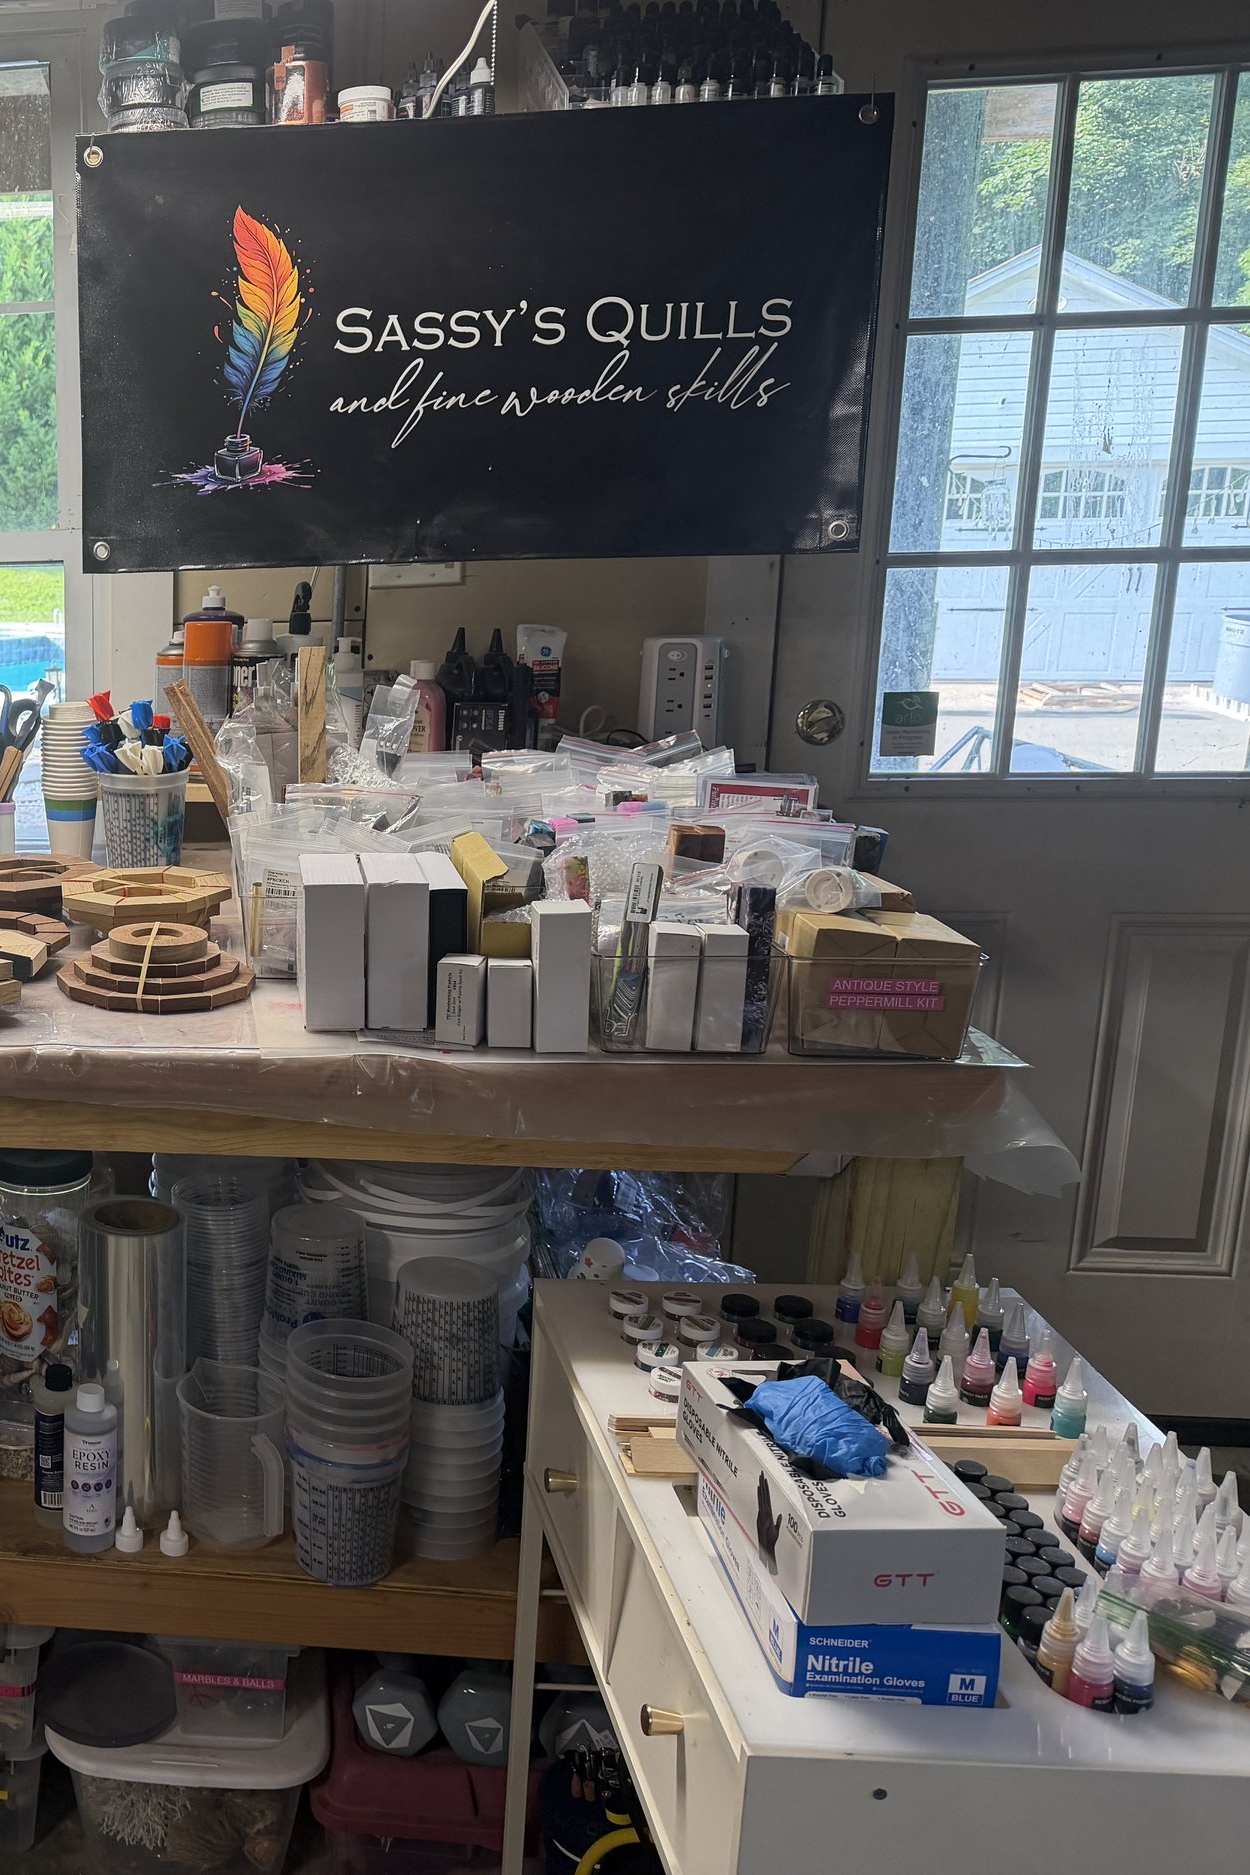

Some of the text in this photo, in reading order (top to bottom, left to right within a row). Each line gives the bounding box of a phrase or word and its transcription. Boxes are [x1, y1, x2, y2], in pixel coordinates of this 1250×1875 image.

[585, 296, 794, 349] QUILLS
[329, 341, 791, 449] and fine wooden skills
[832, 980, 939, 992] ANTIQUE STYLE
[829, 995, 938, 1008] PEPPERMILL KIT
[13, 1287, 40, 1300] BUTTER
[682, 1411, 704, 1444] GLOVES
[683, 1398, 739, 1478] DISPOSABLE NITRILE
[72, 1449, 110, 1462] EPOXY
[75, 1460, 109, 1471] RESIN
[812, 1481, 847, 1519] GLOVES
[911, 1469, 966, 1517] GTT
[787, 1512, 799, 1533] 100
[873, 1573, 935, 1588] GTT
[809, 1636, 869, 1648] SCHNEIDER
[807, 1655, 875, 1674] Nitrile
[182, 1674, 275, 1689] MARBLES & BALLS
[806, 1672, 926, 1688] Examination Gloves
[959, 1678, 976, 1691] M
[951, 1694, 979, 1703] BLUE
